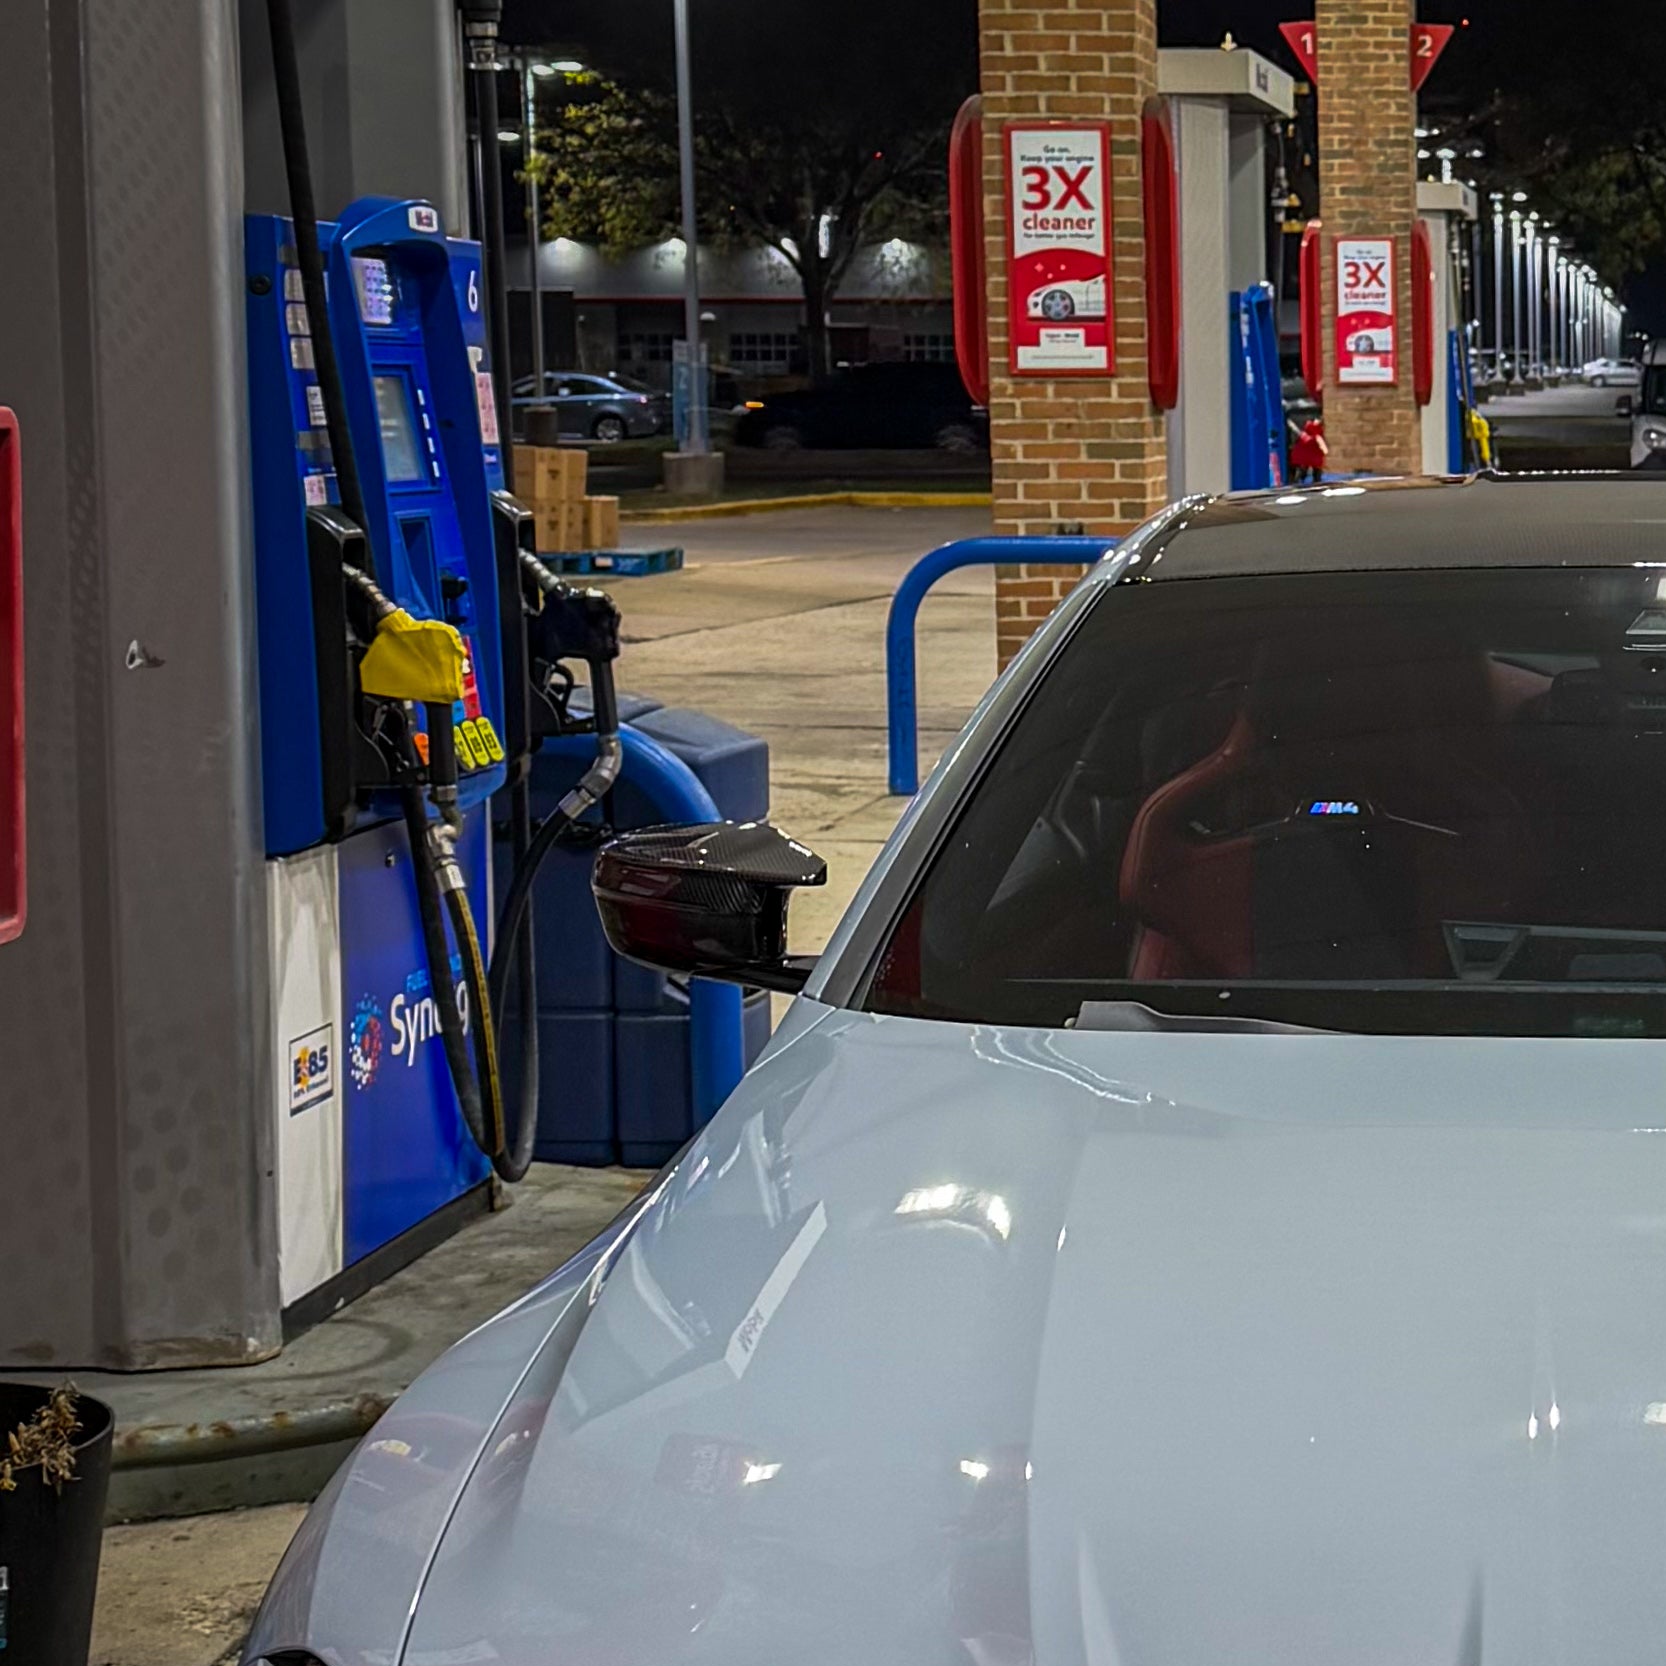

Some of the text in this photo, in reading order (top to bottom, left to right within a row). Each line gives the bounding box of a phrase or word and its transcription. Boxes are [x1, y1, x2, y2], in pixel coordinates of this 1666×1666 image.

[1301, 32, 1314, 55] 1
[1416, 34, 1433, 57] 2
[1021, 165, 1096, 211] 3X
[1022, 212, 1096, 230] cleaner
[468, 270, 478, 313] 6
[1343, 261, 1387, 289] 3X
[390, 980, 470, 1067] Syng
[293, 1045, 329, 1086] E85
